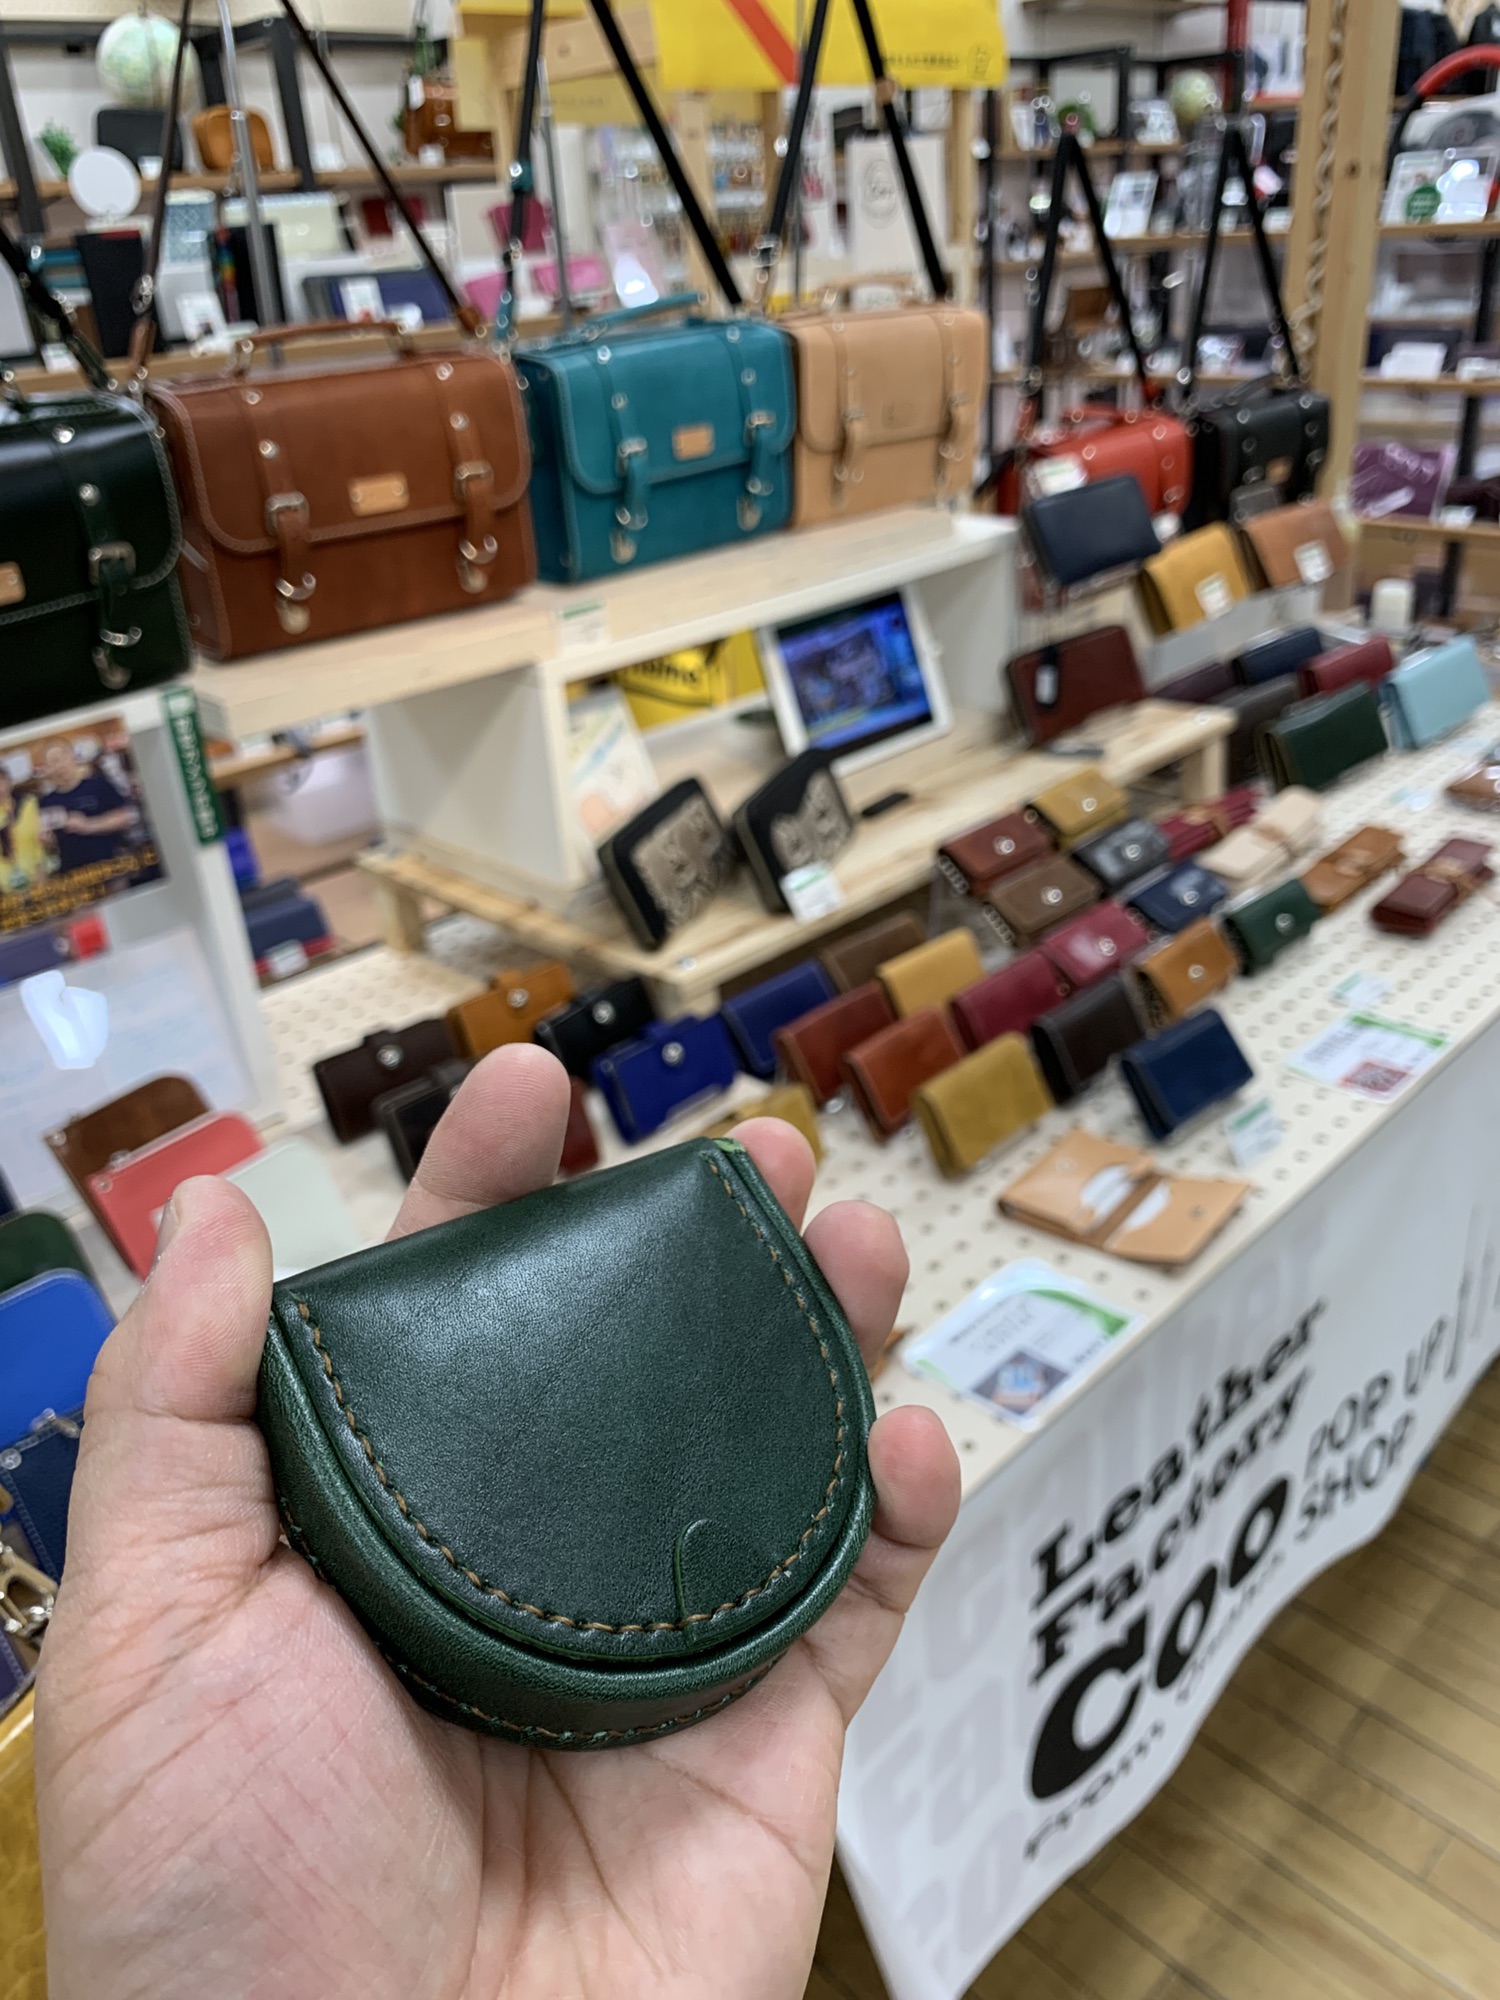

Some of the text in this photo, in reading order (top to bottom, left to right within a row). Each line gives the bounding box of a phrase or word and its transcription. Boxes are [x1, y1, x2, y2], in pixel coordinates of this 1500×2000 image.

[1031, 1297, 1327, 1612] Leather
[1031, 1365, 1312, 1690] Factory
[1296, 1408, 1413, 1542] SHOP
[1305, 1370, 1393, 1482] POP
[1030, 1474, 1290, 1800] Coo
